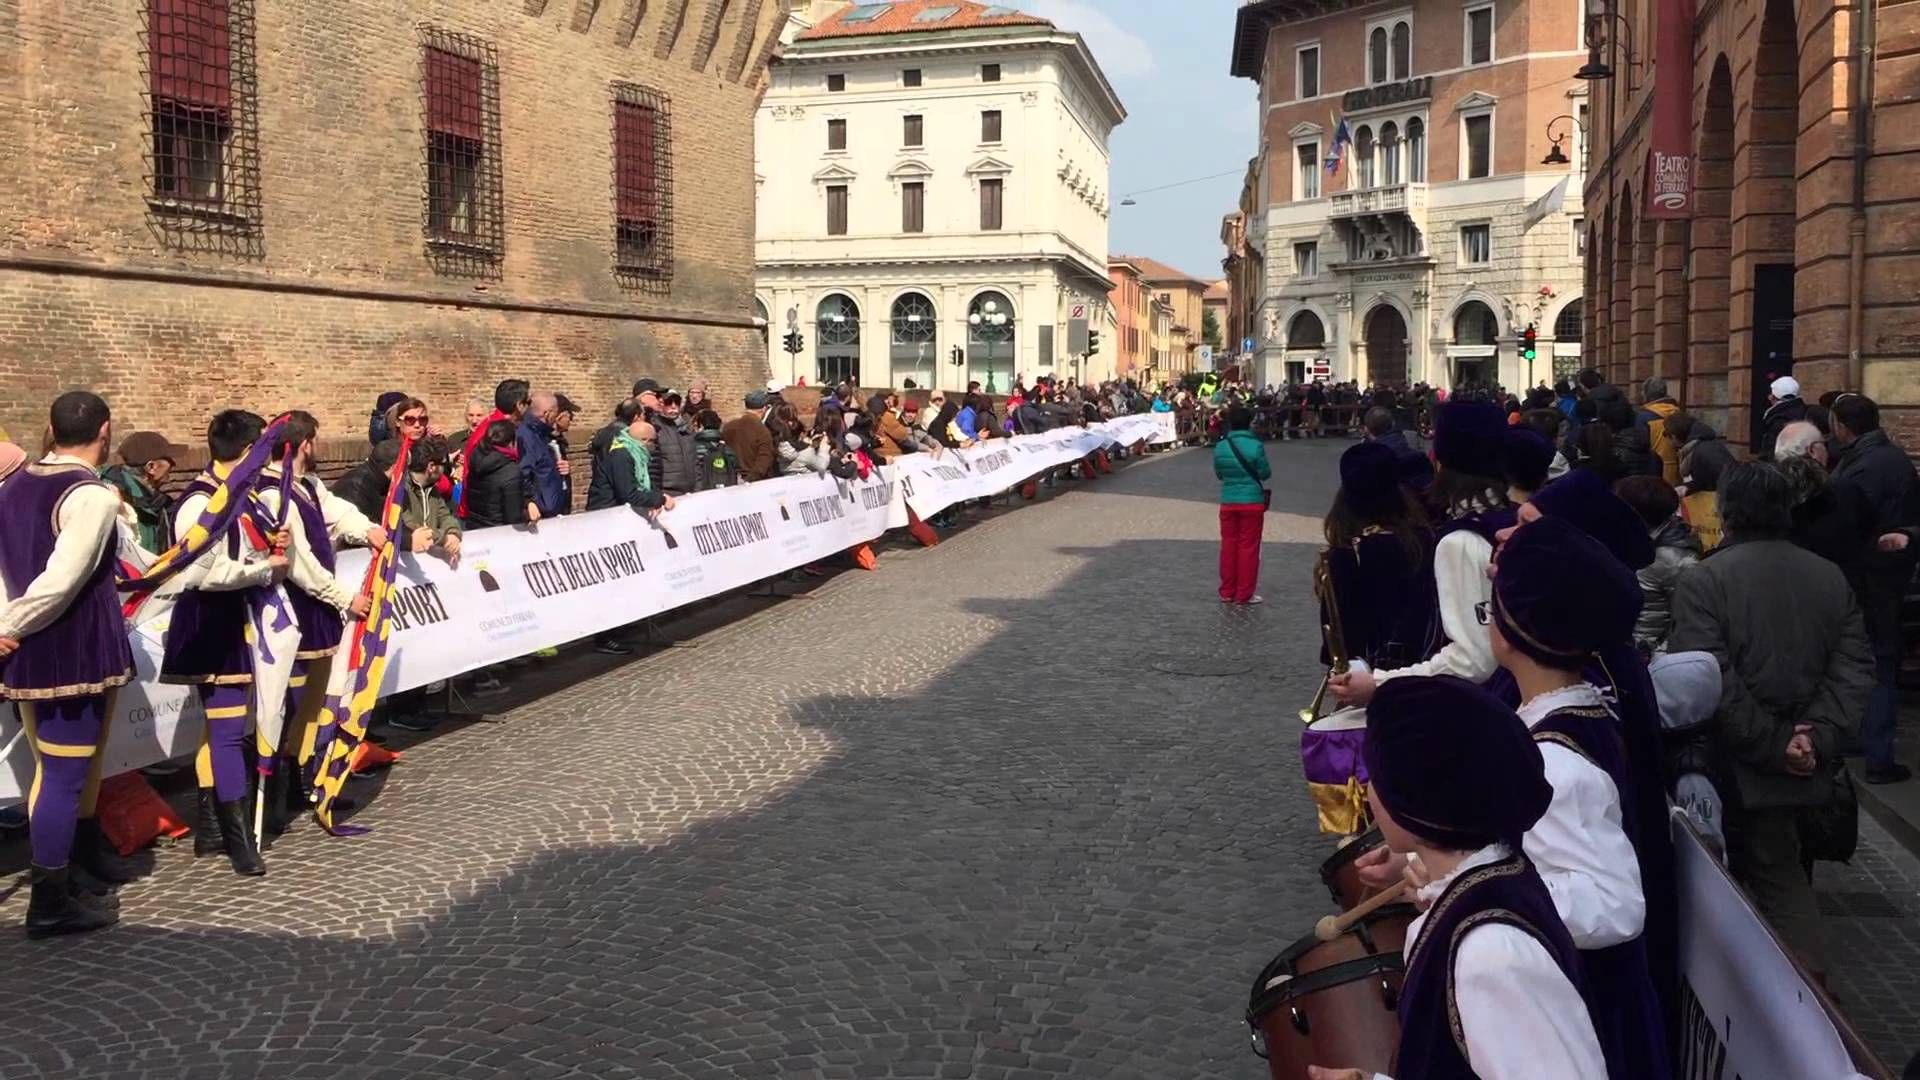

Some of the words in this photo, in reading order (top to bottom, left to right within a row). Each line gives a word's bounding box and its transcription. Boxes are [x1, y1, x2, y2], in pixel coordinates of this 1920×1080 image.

[1654, 152, 1689, 173] TEATRO
[1654, 183, 1662, 193] DI
[1662, 182, 1689, 193] FERRARA
[715, 518, 745, 549] DELLO
[739, 512, 769, 543] SPORT
[522, 552, 568, 599] CITTÀ
[559, 550, 605, 590] DELLO
[598, 540, 645, 579] SPORT
[129, 698, 182, 724] COMUNE
